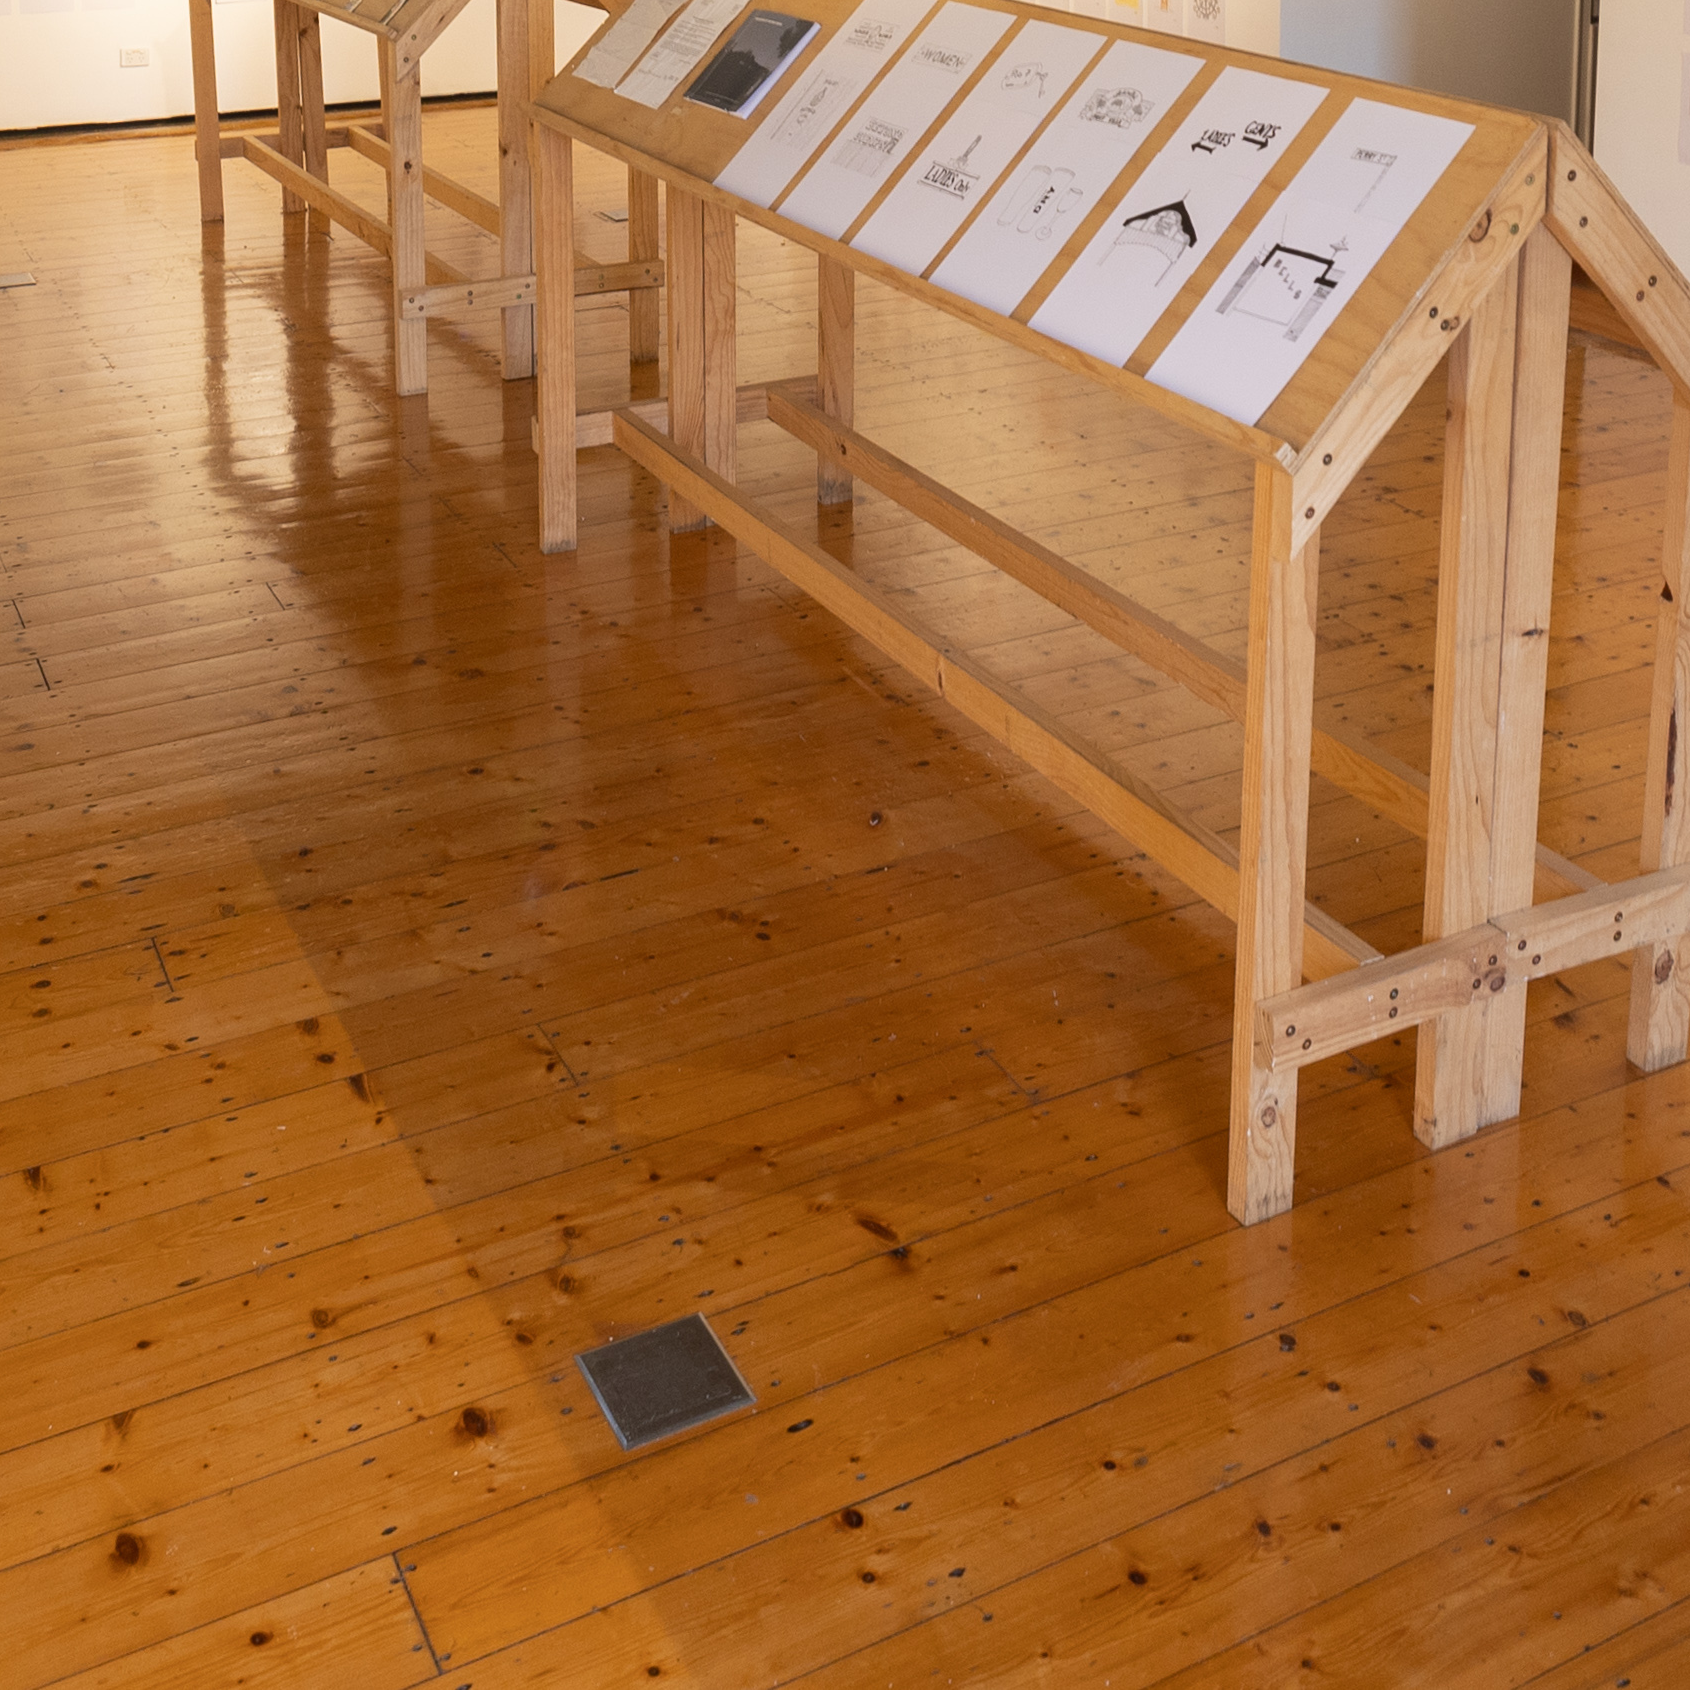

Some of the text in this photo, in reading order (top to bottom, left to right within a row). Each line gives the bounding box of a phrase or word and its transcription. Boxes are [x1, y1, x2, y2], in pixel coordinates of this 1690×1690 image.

[922, 47, 962, 68] WOMEN
[1200, 128, 1236, 148] LADIES
[1243, 120, 1282, 140] GENTS
[923, 165, 958, 188] LADIES
